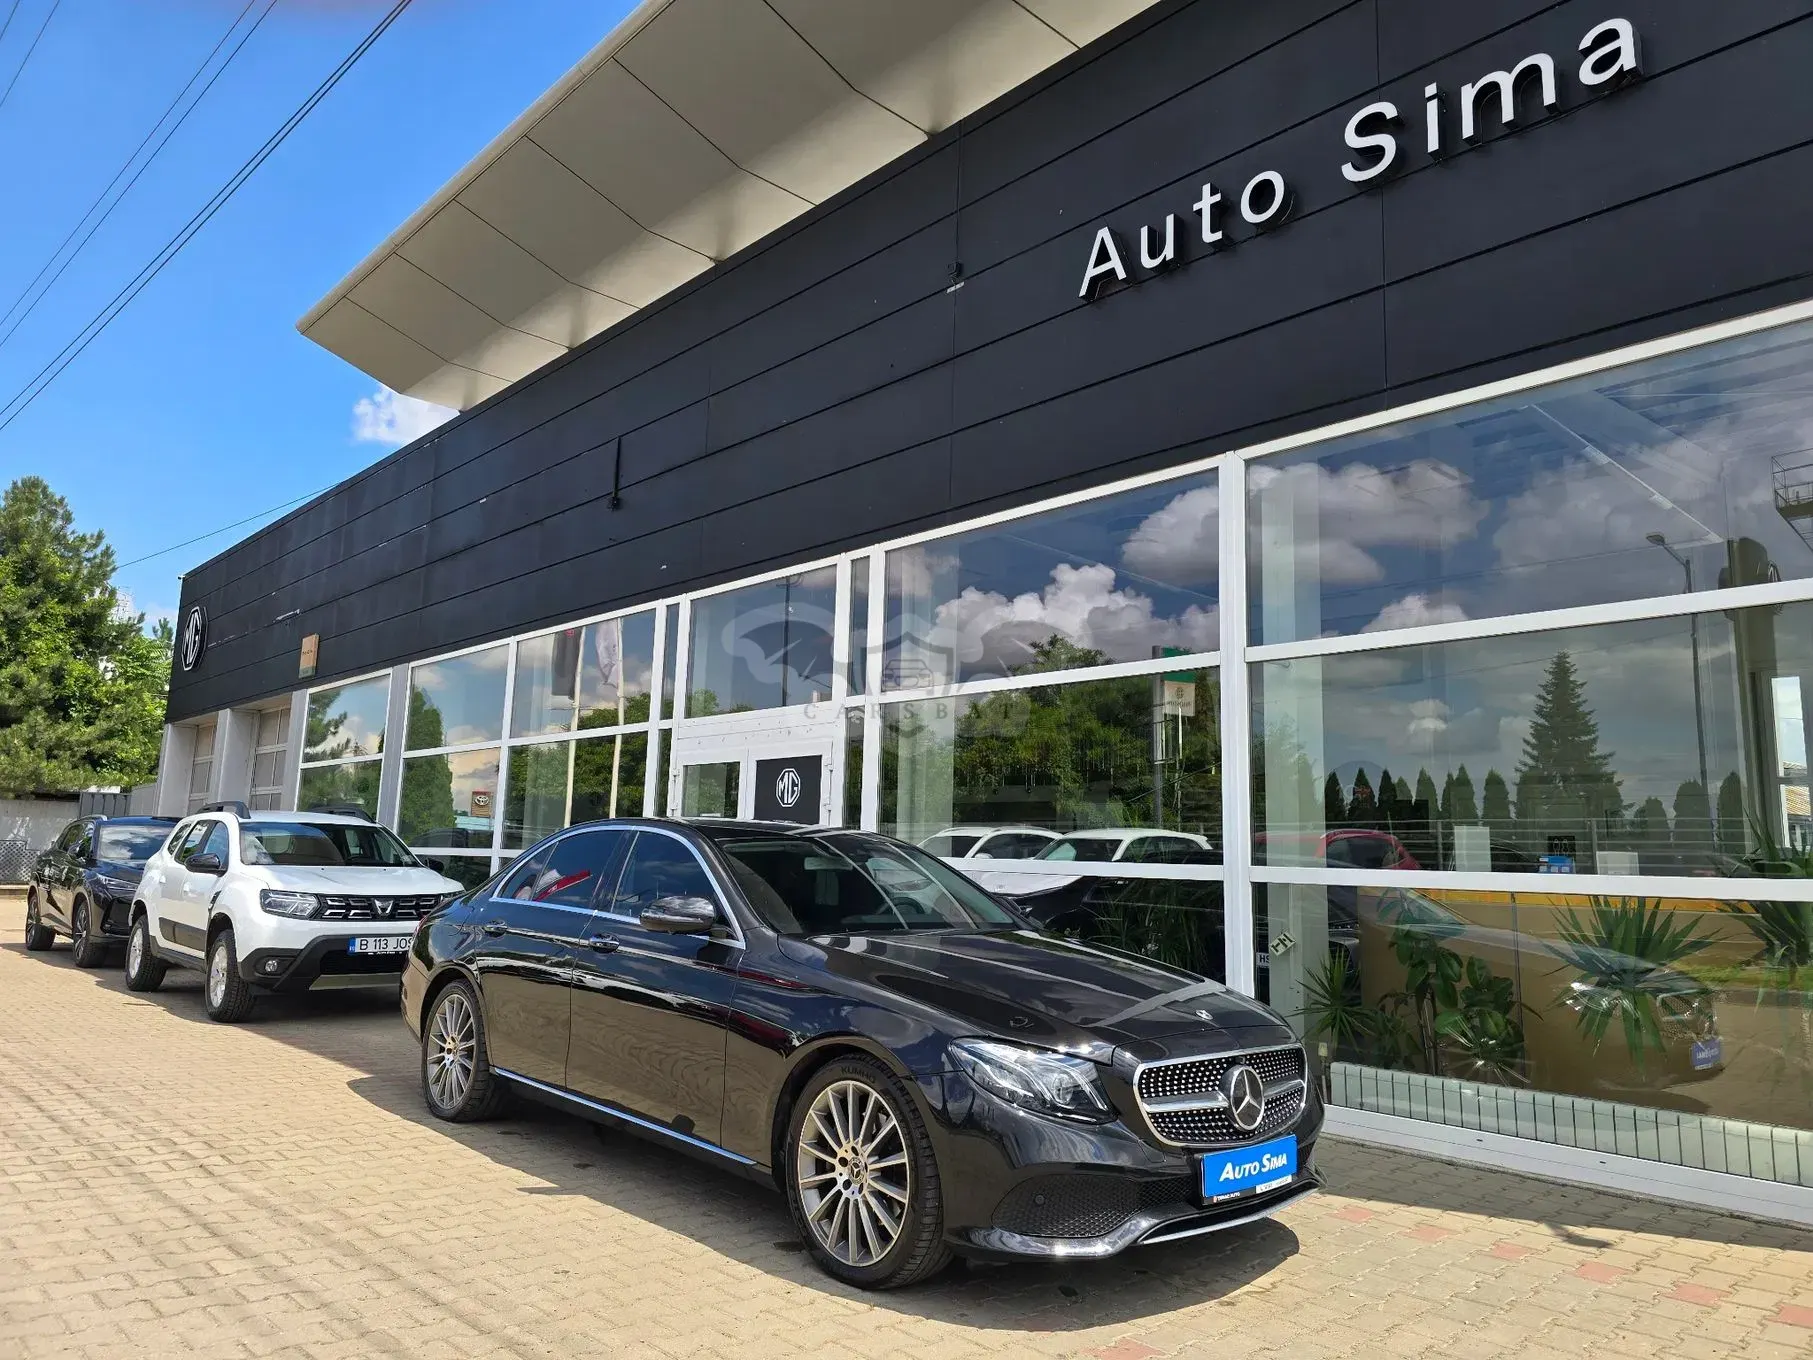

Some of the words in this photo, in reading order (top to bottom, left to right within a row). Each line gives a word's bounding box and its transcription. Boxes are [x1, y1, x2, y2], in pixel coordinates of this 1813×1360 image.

[1078, 170, 1285, 298] Auto
[1341, 17, 1638, 183] Sima
[182, 608, 201, 669] MG
[777, 769, 799, 806] MG
[360, 939, 369, 950] B
[373, 938, 388, 950] 113
[840, 1066, 876, 1084] KUMHO
